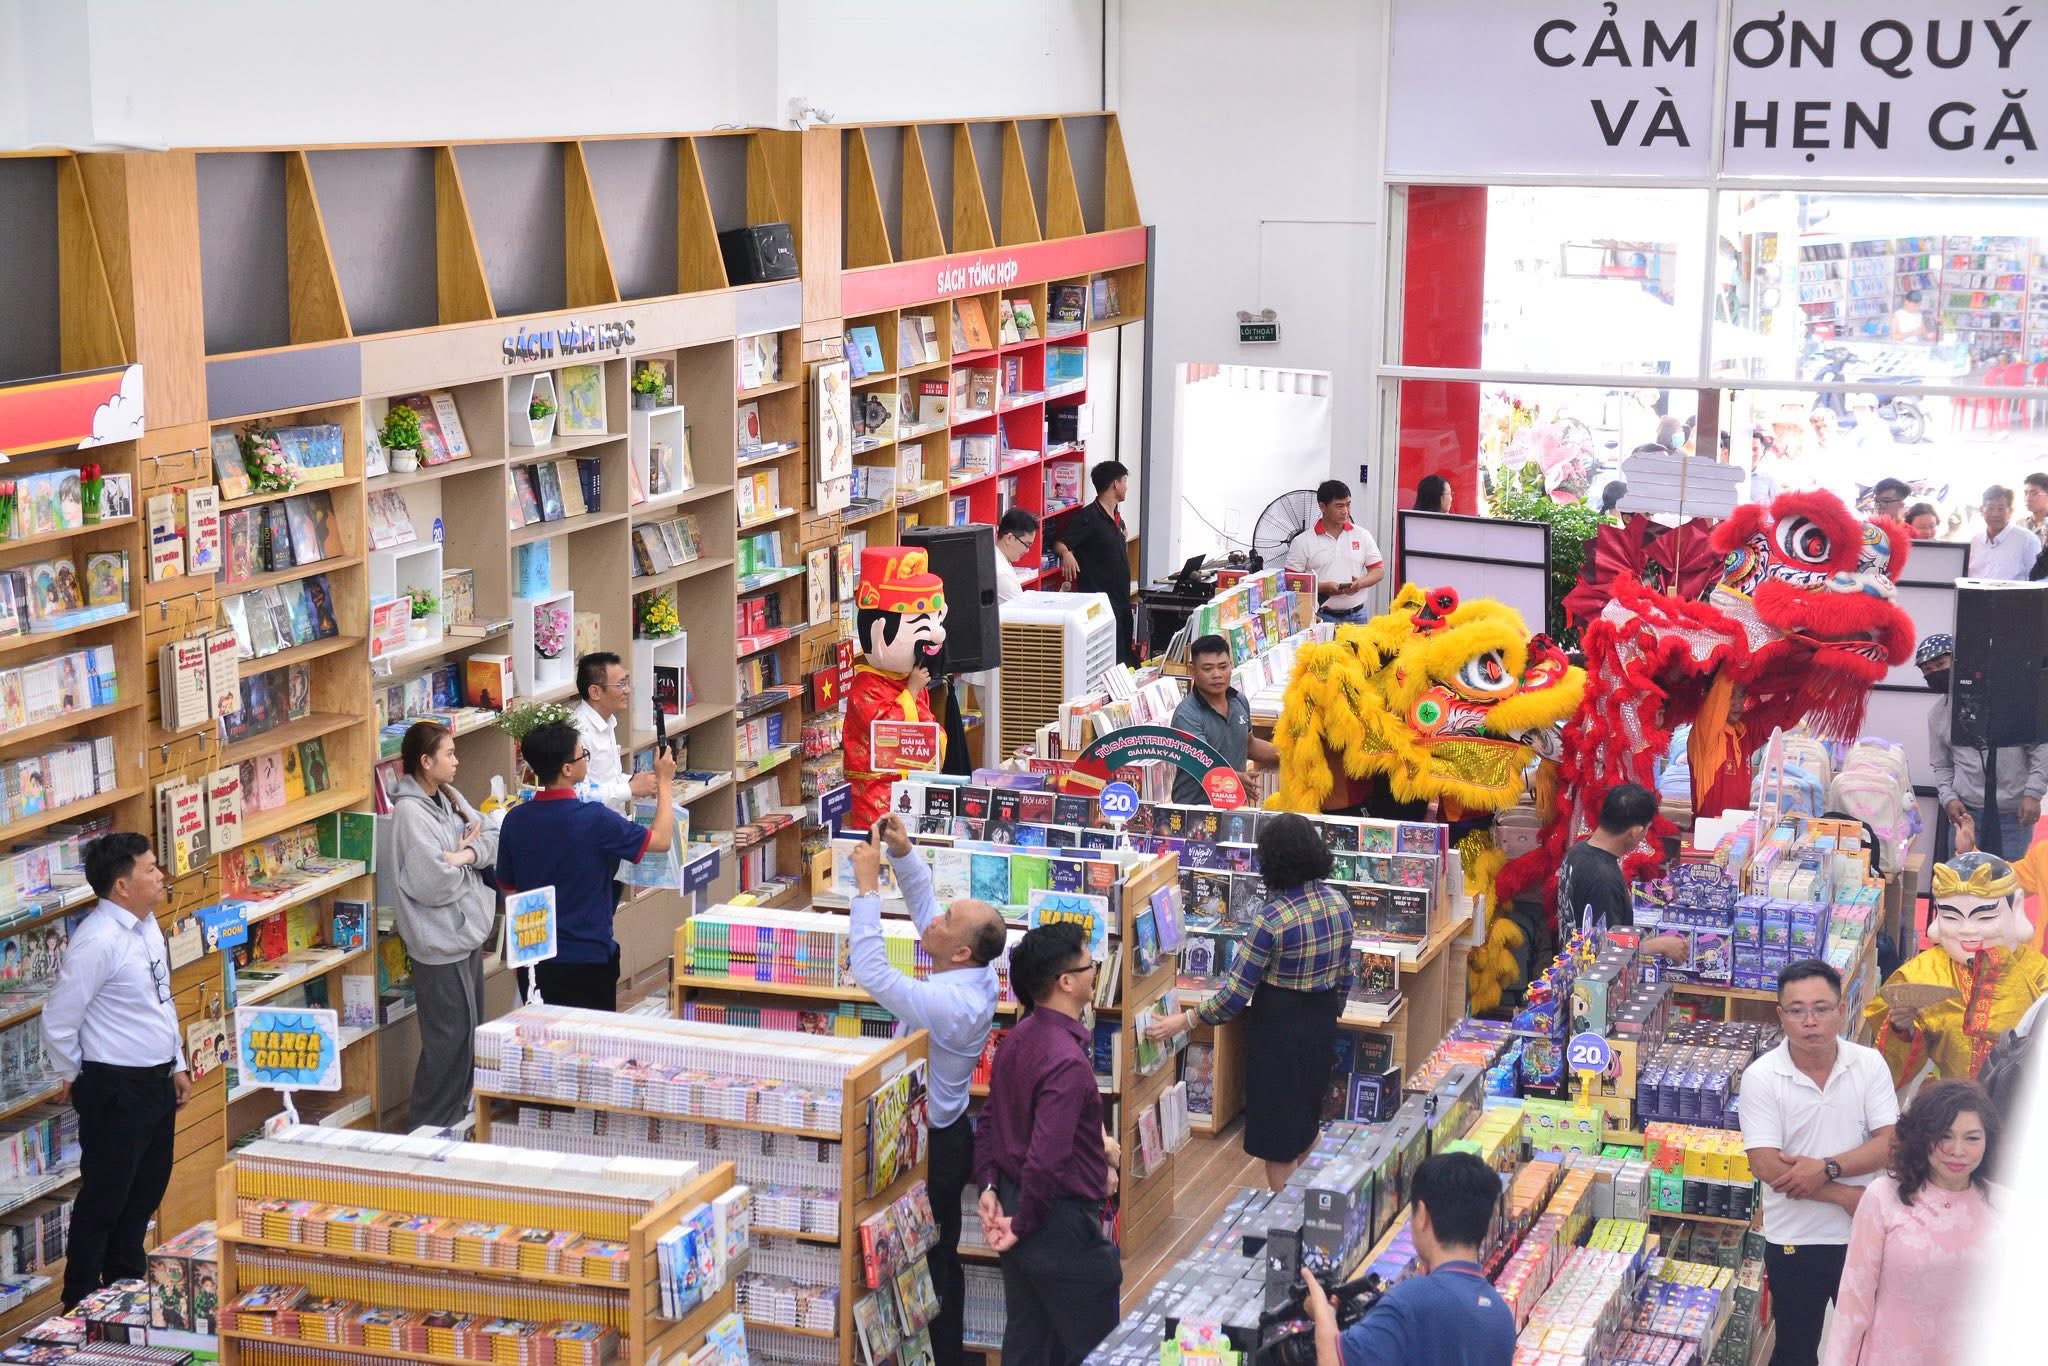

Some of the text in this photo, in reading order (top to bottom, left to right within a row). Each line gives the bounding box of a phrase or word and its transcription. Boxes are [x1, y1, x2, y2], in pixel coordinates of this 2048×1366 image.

[1533, 2, 2033, 80] CẢM ƠN QUÝ
[1590, 86, 1691, 148] VÀ
[1733, 100, 1891, 163] HẸN
[937, 256, 1018, 294] SÁCH TỔNG HỢP
[503, 320, 636, 365] SÁCH VĂN HỌC
[900, 737, 926, 746] GIẢI MÃ
[901, 744, 930, 757] KỲ ÁN
[1095, 735, 1214, 768] TỦ SÁCH TRINH THÁM
[1127, 747, 1183, 761] GIẢI MÃ KỲ ÁN
[1211, 775, 1239, 794] 50
[1022, 795, 1035, 806] Bội
[1035, 796, 1049, 806] ước
[516, 907, 549, 932] MANGA
[221, 924, 244, 939] ROOM
[518, 925, 549, 949] COMIC
[250, 1030, 321, 1052] MANGA
[254, 1049, 319, 1071] COMIC
